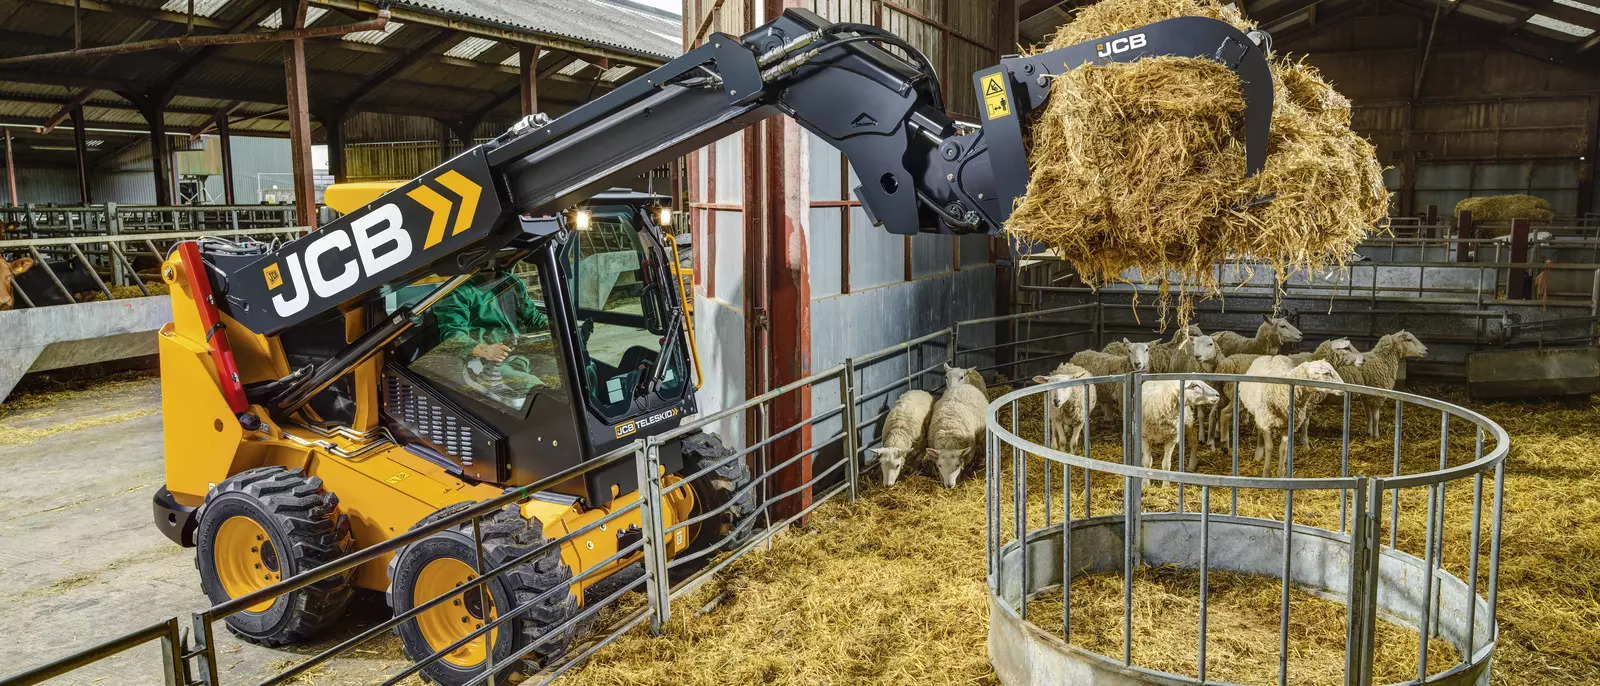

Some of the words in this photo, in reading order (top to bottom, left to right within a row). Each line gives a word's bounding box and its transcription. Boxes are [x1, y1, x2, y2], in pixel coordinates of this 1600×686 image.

[1098, 33, 1147, 58] JCB
[271, 203, 413, 318] JCB
[617, 423, 634, 436] JCB
[635, 410, 672, 428] TELESKID
